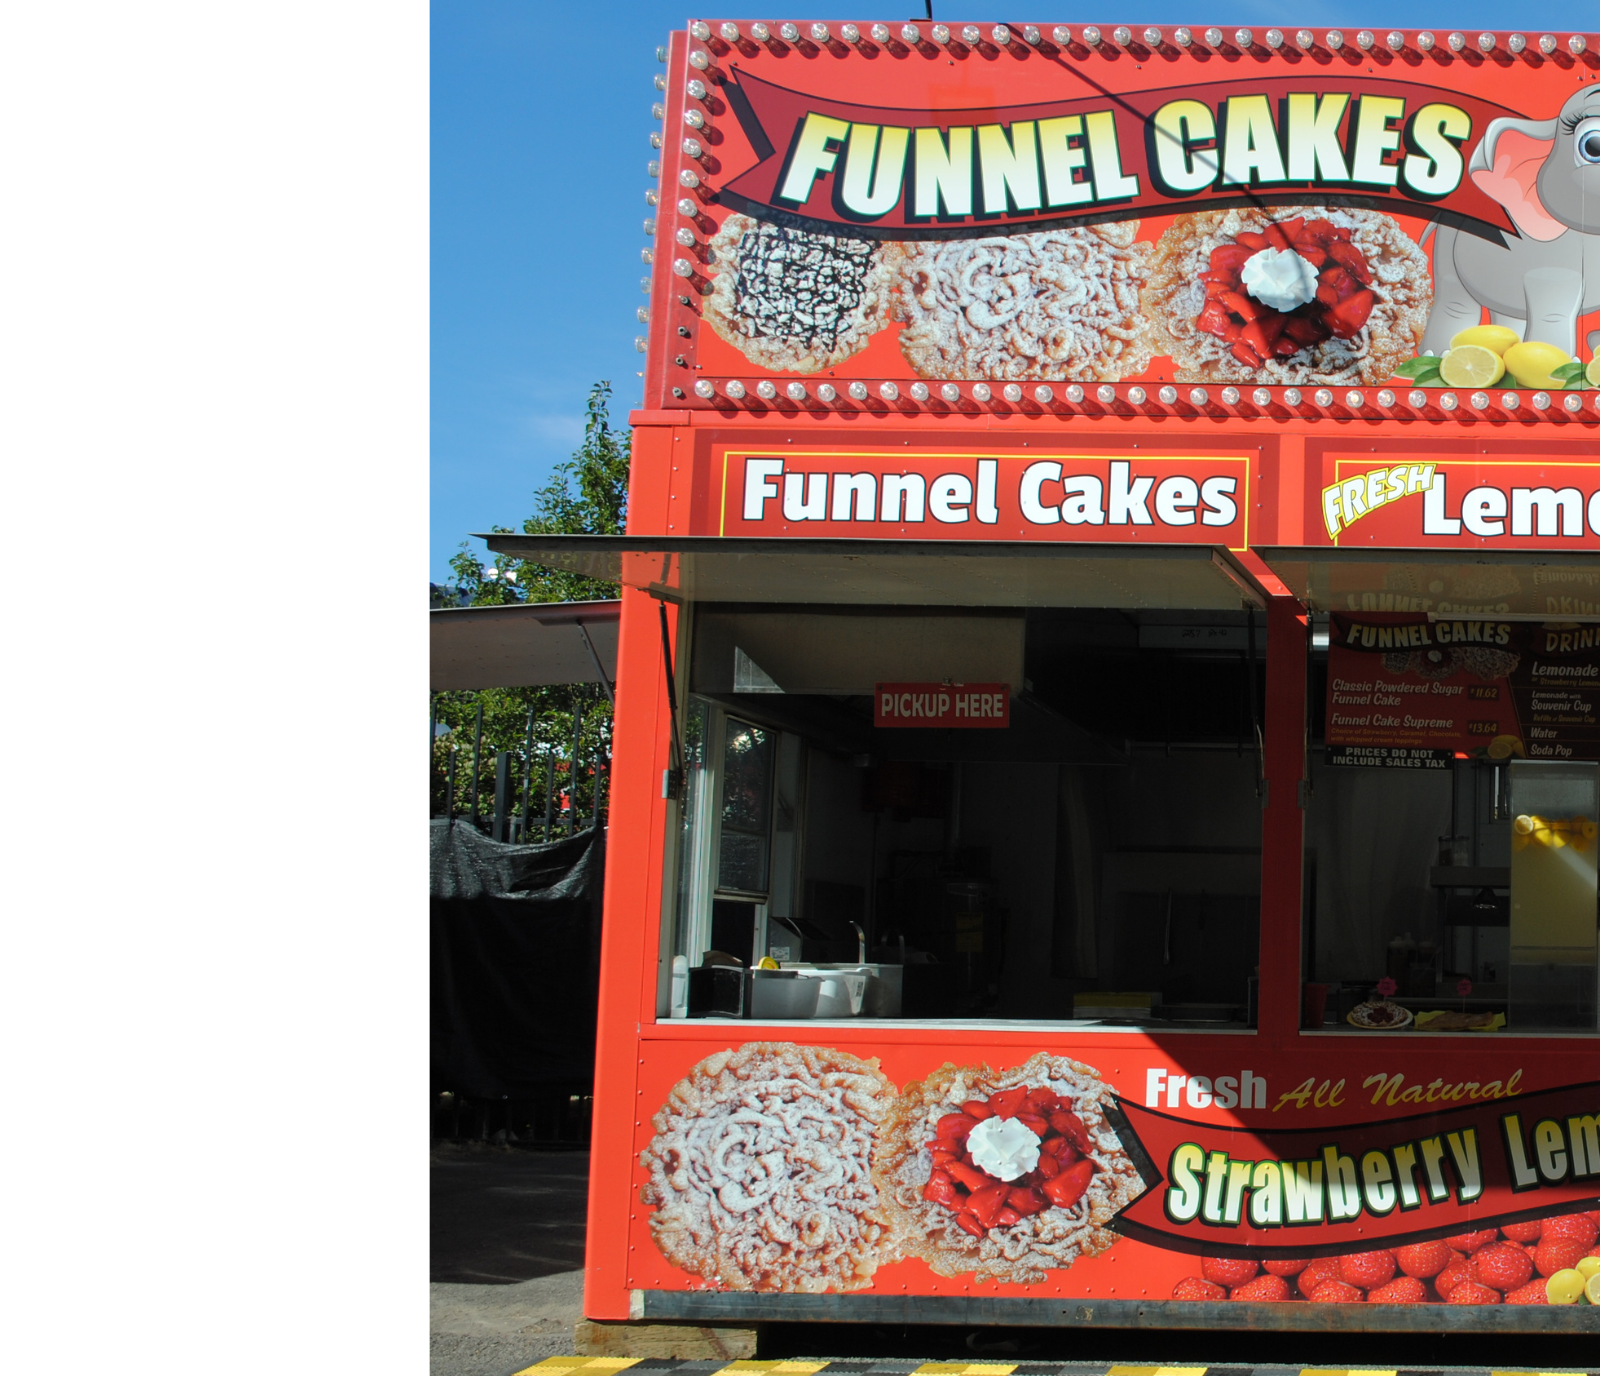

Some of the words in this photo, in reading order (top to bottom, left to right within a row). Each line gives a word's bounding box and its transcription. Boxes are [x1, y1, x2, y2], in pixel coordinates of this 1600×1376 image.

[779, 110, 1140, 218] FUNNEL
[1150, 92, 1473, 198] CAKES
[742, 458, 1000, 525] Funnel
[1019, 460, 1238, 527] Cakes
[1321, 463, 1437, 541] FRESH
[1346, 623, 1432, 648] FUNNEL
[1436, 622, 1511, 645] CAKES
[1532, 661, 1598, 677] Lemonade
[1332, 679, 1372, 692] Classic
[1374, 680, 1428, 694] Powdered
[1432, 682, 1463, 696] Sugar
[1540, 678, 1577, 687] Strawberry
[1332, 692, 1370, 705] Funnel
[1373, 693, 1401, 705] Cake
[1532, 691, 1568, 699] Lemonade
[881, 693, 950, 717] PICKUP
[955, 694, 1003, 717] HERE
[1531, 700, 1571, 711] Souvenir
[1574, 701, 1592, 713] Cup
[1331, 713, 1370, 725] Funnel
[1372, 714, 1400, 727] Cake
[1403, 715, 1453, 729] Supreme
[1584, 715, 1596, 723] Cup
[1468, 723, 1497, 733] $13.64
[1531, 727, 1558, 739] Water
[1345, 747, 1388, 757] PRICES
[1391, 748, 1407, 757] DO
[1411, 749, 1434, 758] NOT
[1531, 745, 1553, 756] Soda
[1555, 745, 1572, 757] Pop
[1332, 756, 1381, 766] INCLUDE
[1386, 757, 1422, 767] SALES
[1425, 758, 1445, 768] TAX
[1145, 1068, 1267, 1109] Fresh
[1272, 1077, 1346, 1113] All
[1362, 1068, 1523, 1106] Natural
[1167, 1125, 1484, 1225] Strawberry
